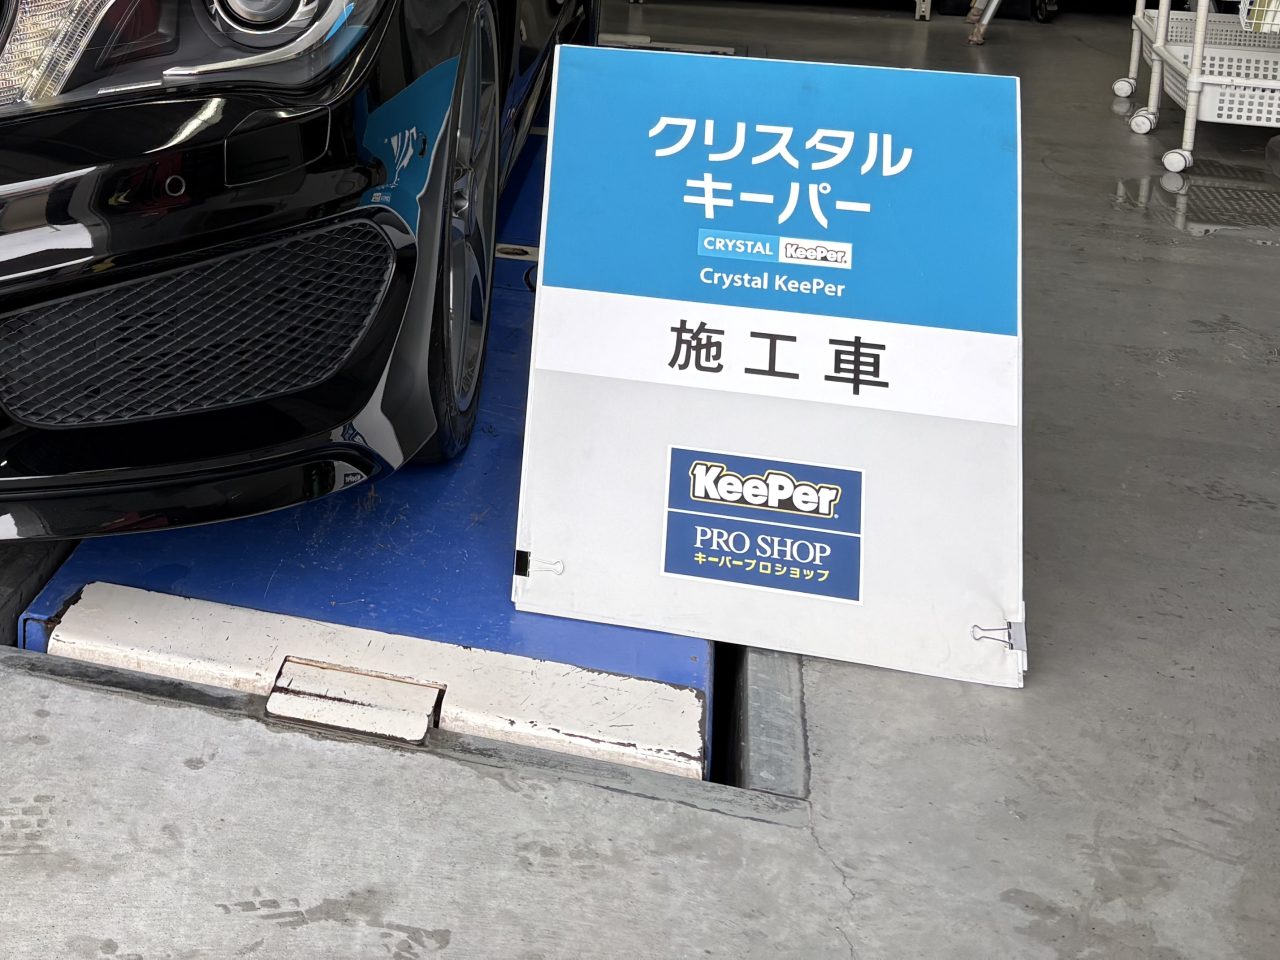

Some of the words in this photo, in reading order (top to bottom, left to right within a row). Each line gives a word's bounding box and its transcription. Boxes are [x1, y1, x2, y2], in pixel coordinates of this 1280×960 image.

[648, 116, 913, 177] クリスタル
[683, 172, 871, 230] キーパー
[703, 236, 774, 255] CRYSTAL
[784, 243, 846, 264] KeePer
[699, 267, 769, 290] Crystal
[774, 274, 846, 297] KeePer
[667, 318, 889, 397] 施工車
[689, 461, 842, 518] KeePer
[693, 525, 751, 555] PRO
[756, 534, 832, 566] SHOP
